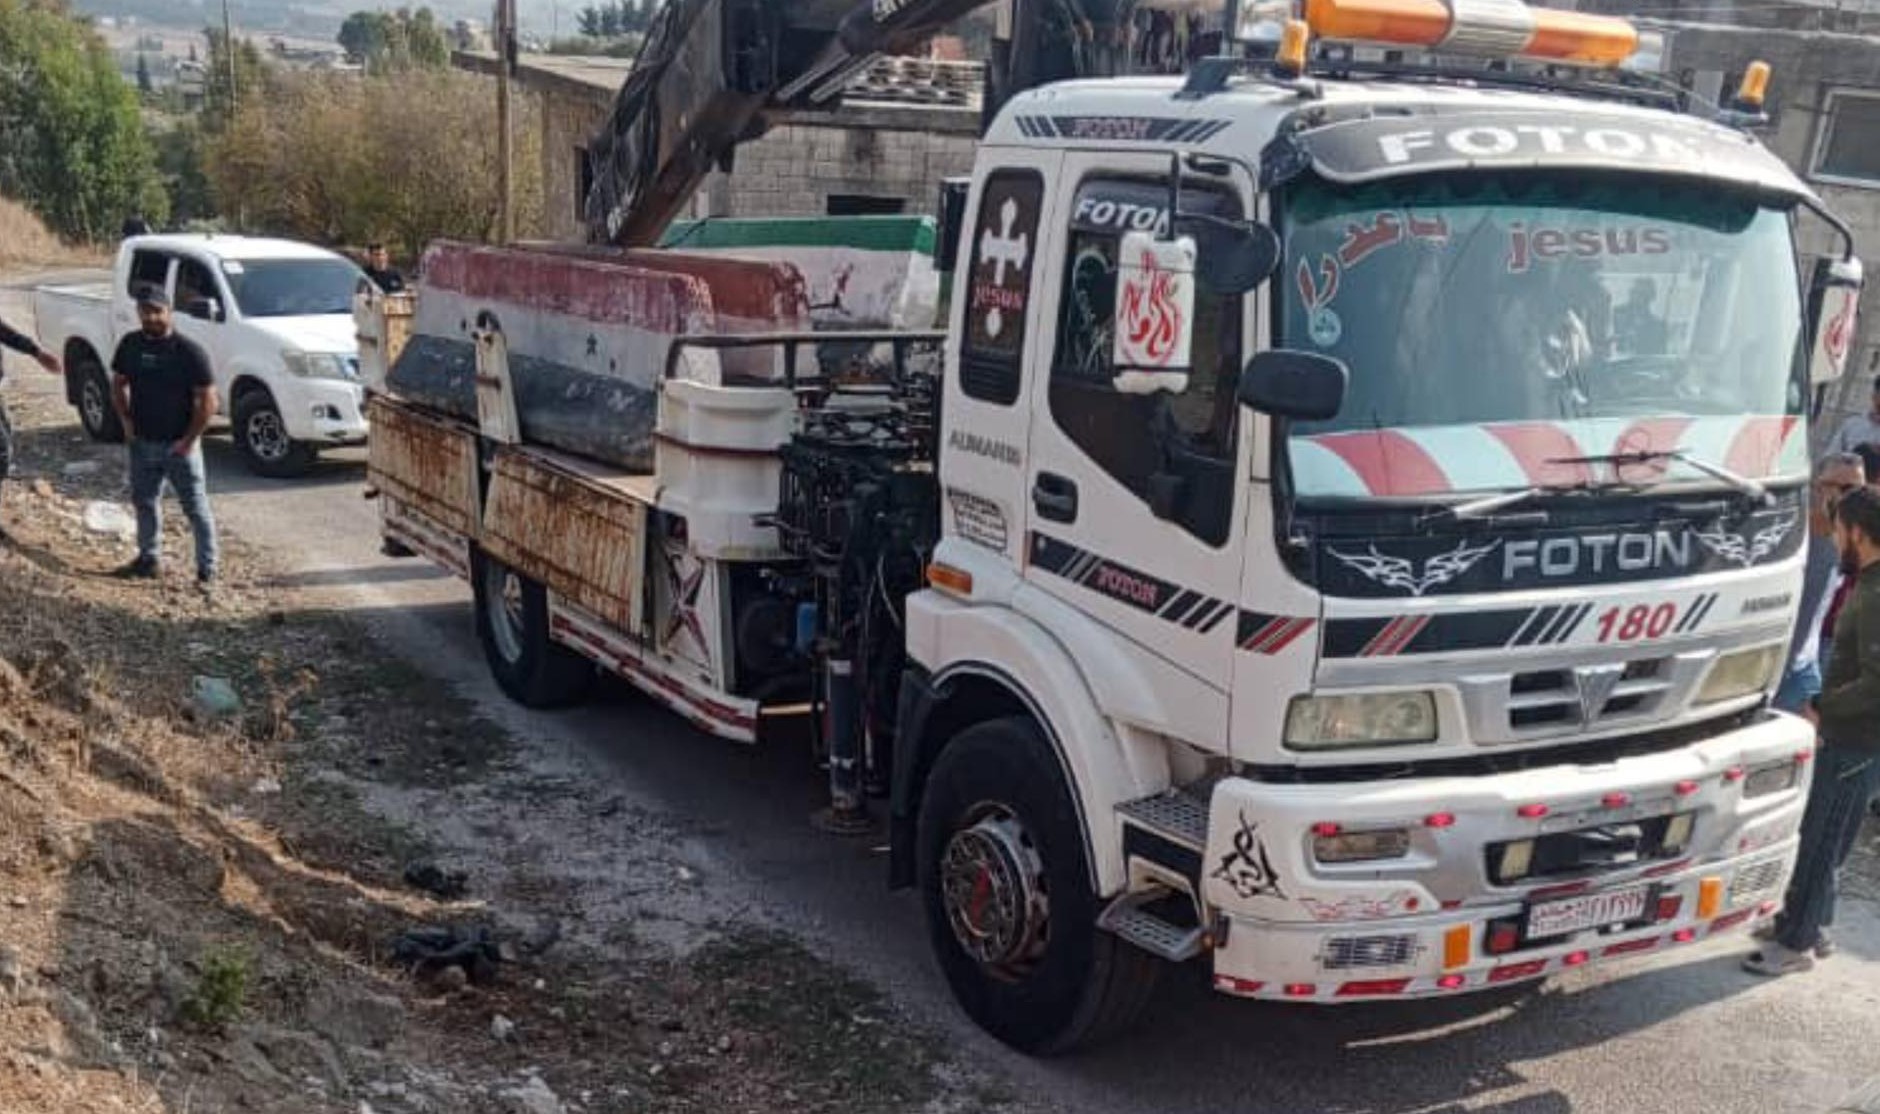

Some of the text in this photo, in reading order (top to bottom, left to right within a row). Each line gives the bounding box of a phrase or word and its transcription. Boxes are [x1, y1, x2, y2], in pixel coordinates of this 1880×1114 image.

[1509, 222, 1671, 273] jesus
[1502, 530, 1689, 581] FOTON
[1598, 602, 1677, 643] 180
